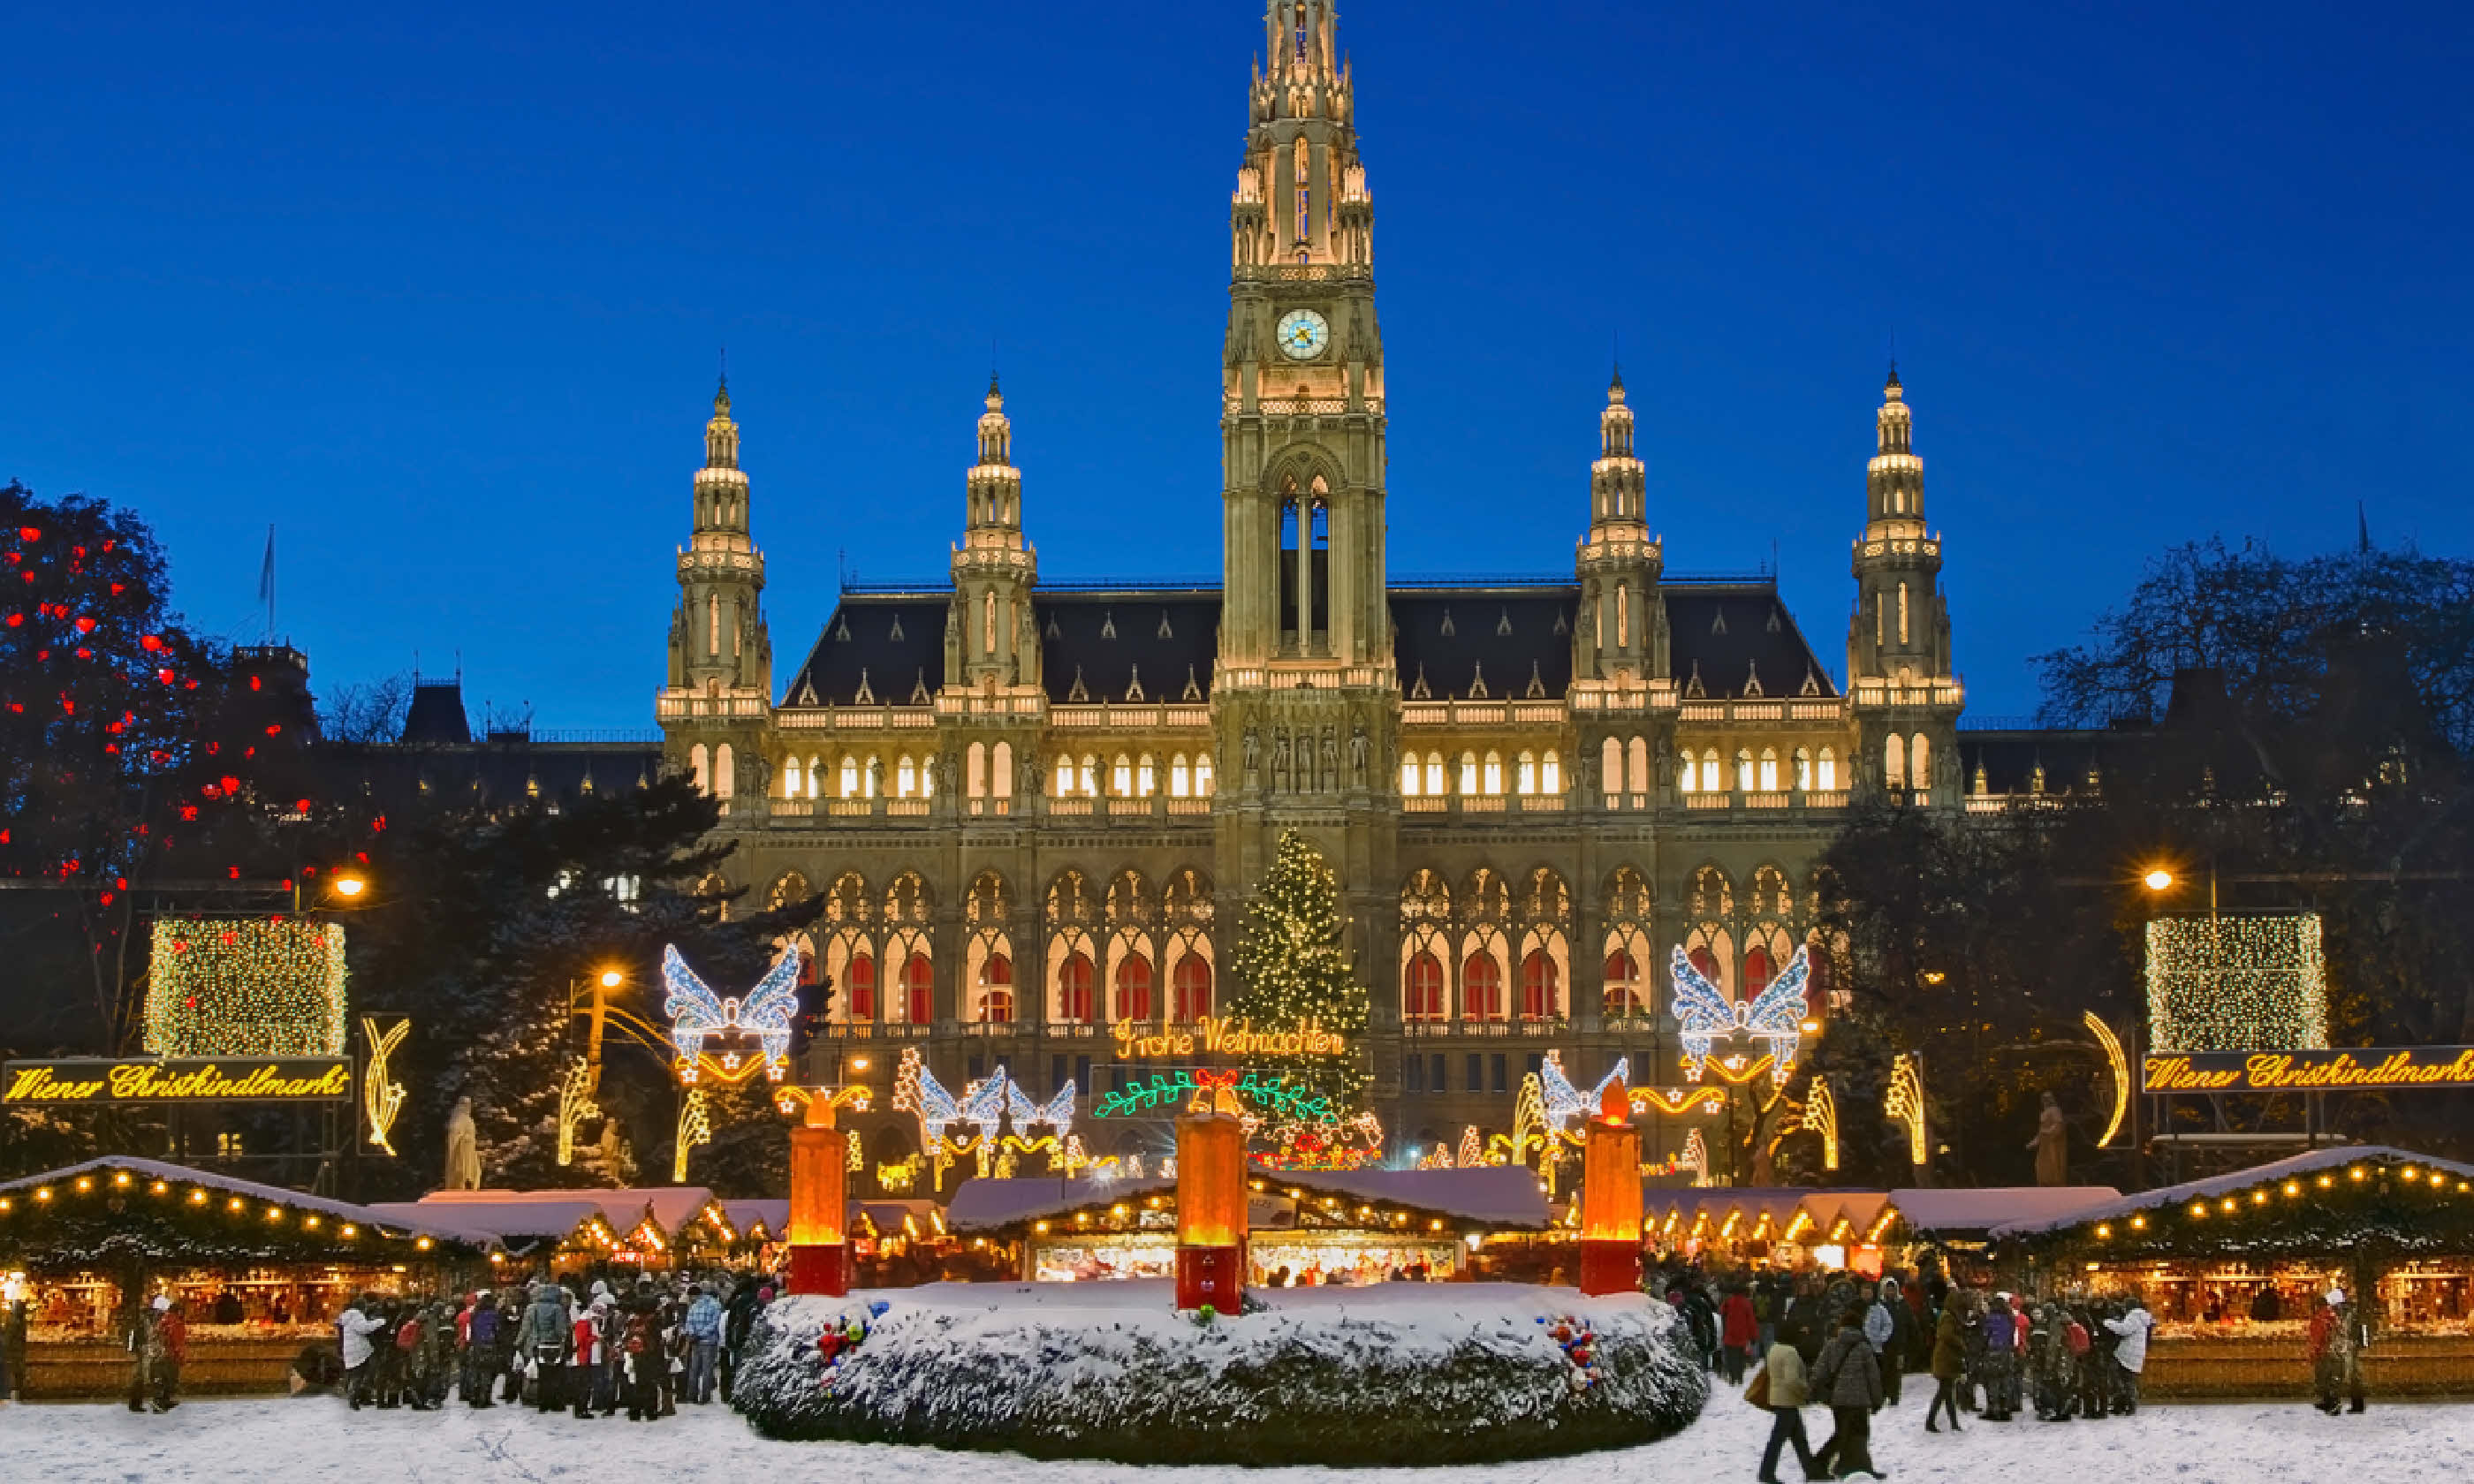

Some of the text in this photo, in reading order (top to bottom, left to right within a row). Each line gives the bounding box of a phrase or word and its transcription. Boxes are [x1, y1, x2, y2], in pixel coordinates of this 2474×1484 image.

[1115, 1016, 1344, 1058] Frohe Weihnachten
[3, 1063, 352, 1102] Wiener Christkindlmarkt
[2144, 1056, 2242, 1091] Wiener
